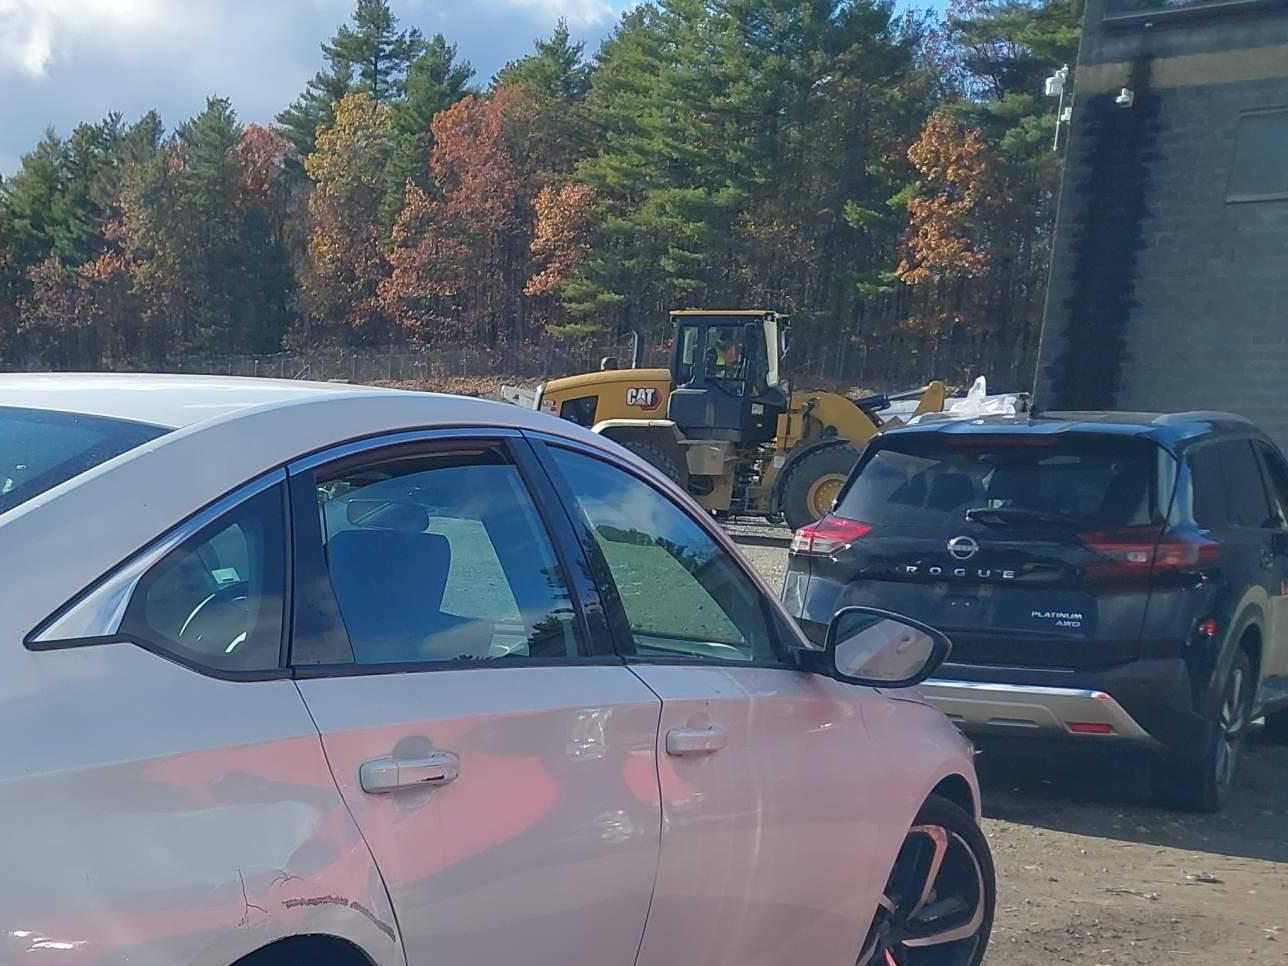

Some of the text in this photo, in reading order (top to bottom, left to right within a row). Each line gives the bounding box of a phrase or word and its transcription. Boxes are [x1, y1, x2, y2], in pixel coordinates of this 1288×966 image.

[627, 388, 655, 406] CAT
[906, 566, 1016, 579] ROGUE
[1031, 611, 1082, 619] PLATINUM
